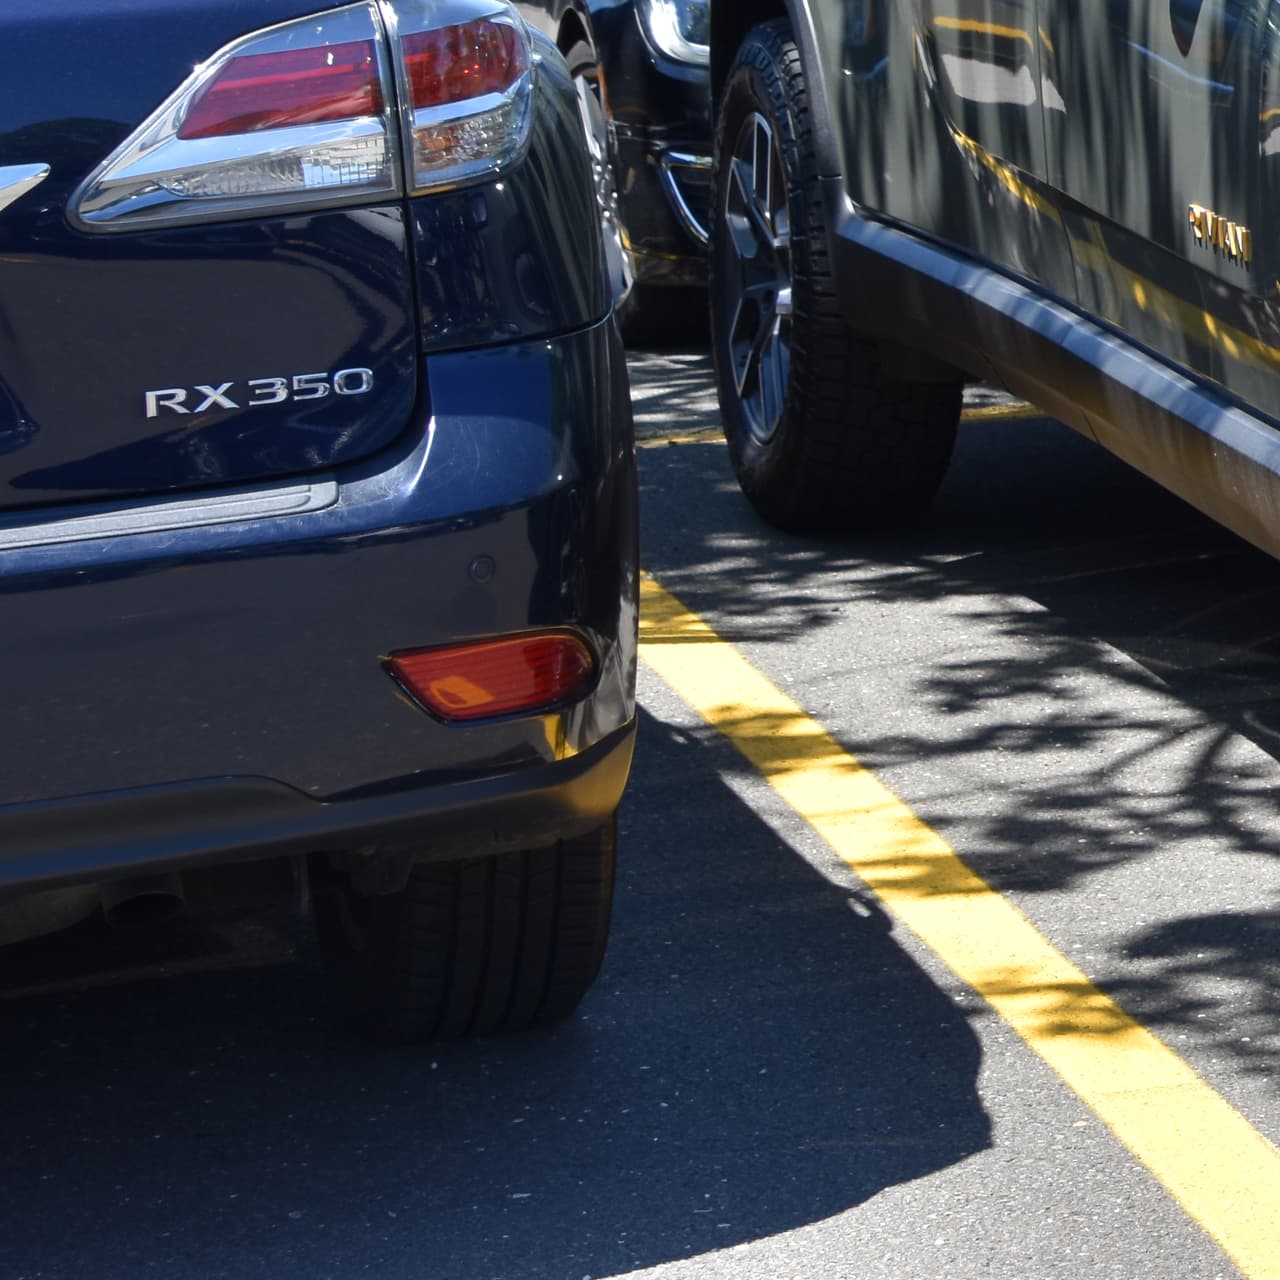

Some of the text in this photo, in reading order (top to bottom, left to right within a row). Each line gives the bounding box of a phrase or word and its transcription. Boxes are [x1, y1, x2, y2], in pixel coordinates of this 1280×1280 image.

[1188, 203, 1253, 263] RIVIAN
[144, 368, 374, 418] RX 350
